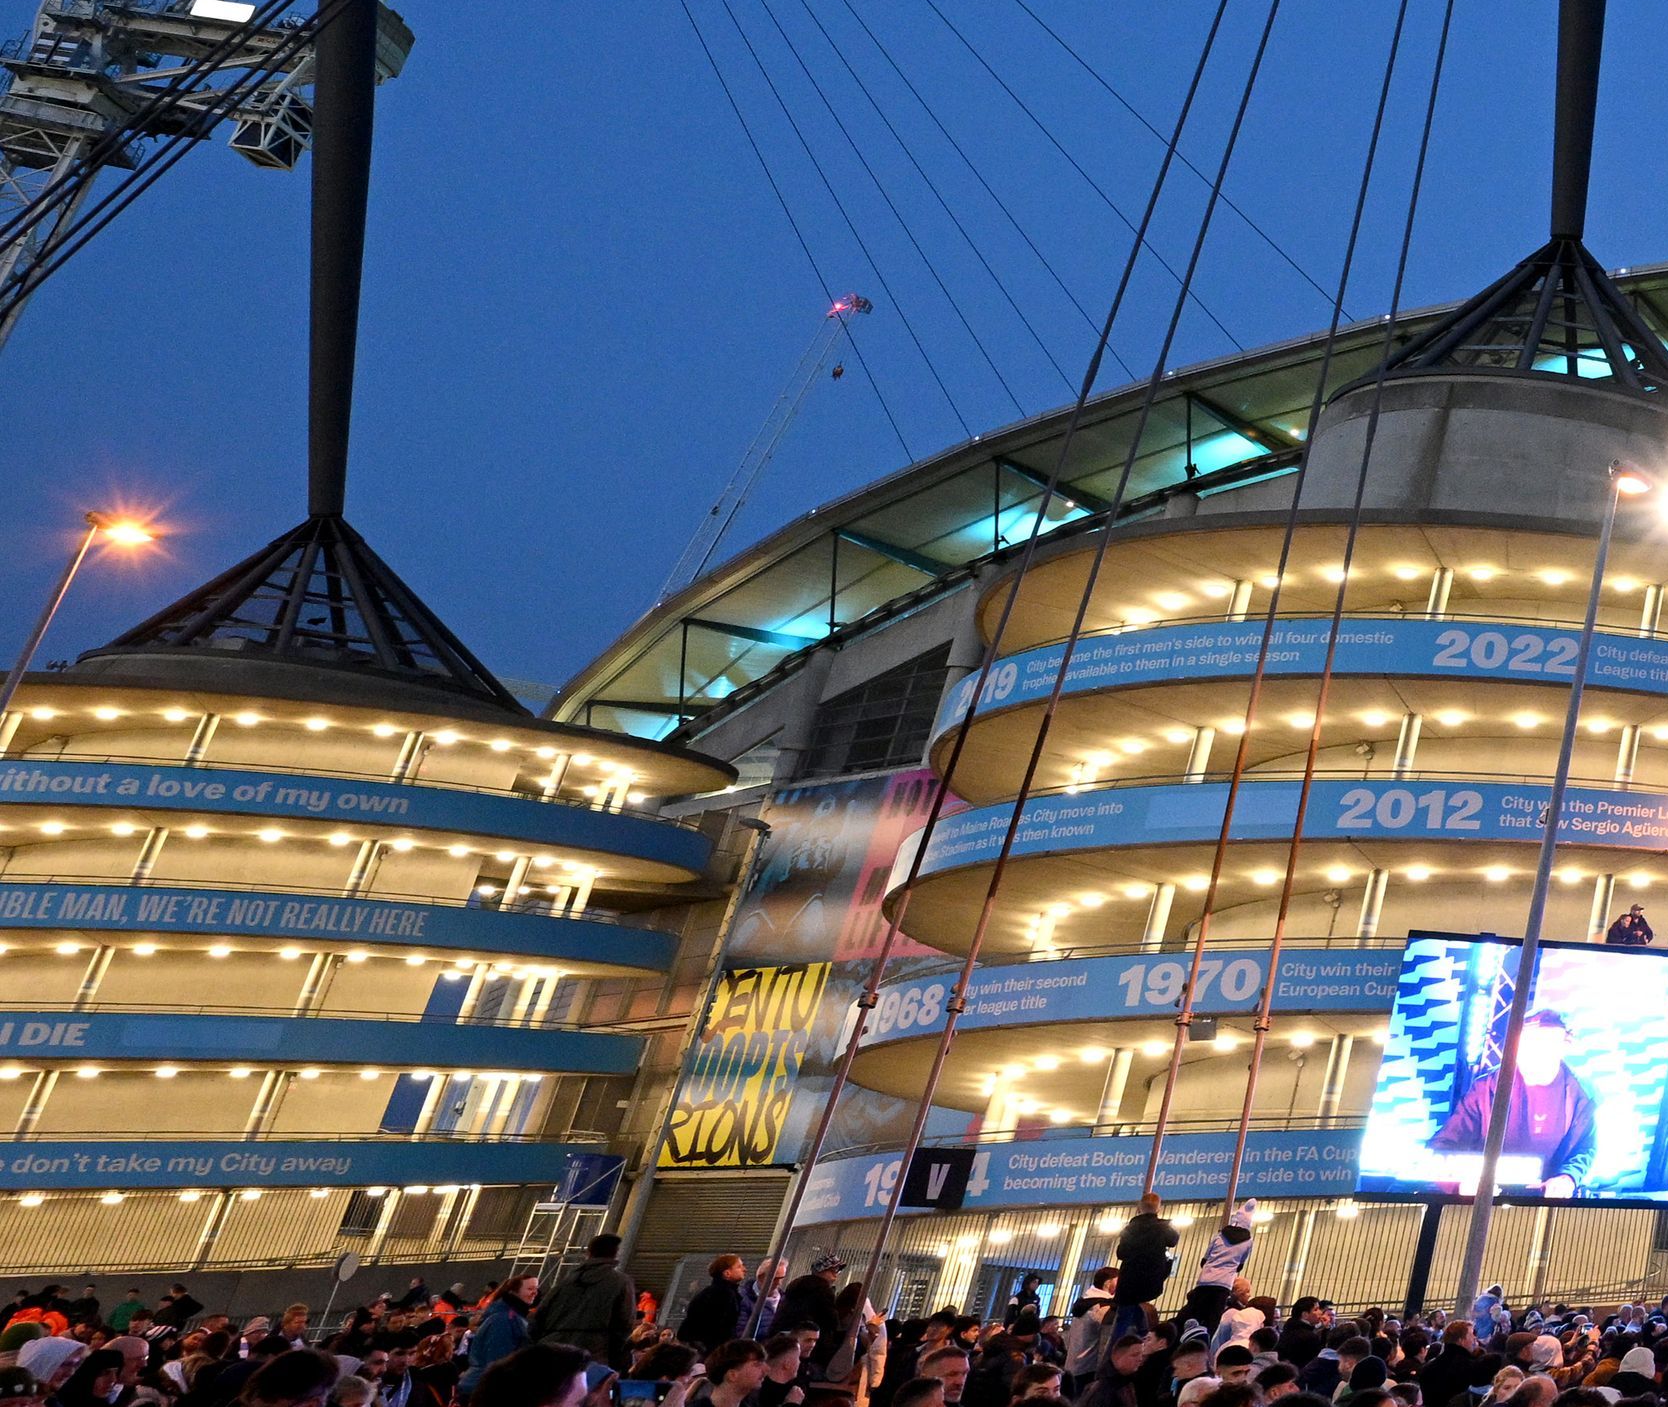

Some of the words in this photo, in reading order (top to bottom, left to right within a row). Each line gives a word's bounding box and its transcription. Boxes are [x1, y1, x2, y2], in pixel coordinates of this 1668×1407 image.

[1027, 659, 1046, 674] City
[1093, 648, 1112, 660] the
[1114, 643, 1141, 657] first
[1143, 638, 1182, 652] men's
[1185, 635, 1214, 648] side
[1217, 635, 1232, 646] to
[1235, 633, 1262, 645] win
[1285, 631, 1317, 644] four
[1432, 630, 1580, 674] 2022
[1596, 645, 1627, 662] City
[1063, 664, 1117, 682] available
[1119, 660, 1133, 673] to
[1135, 655, 1168, 670] them
[1171, 654, 1183, 666] in
[1198, 651, 1241, 666] single
[1595, 663, 1647, 681] League
[0, 770, 111, 794] ithout
[116, 778, 139, 796] a
[147, 775, 225, 800] love
[233, 781, 272, 803] of
[275, 788, 329, 812] my
[337, 793, 409, 814] own
[1033, 808, 1057, 823] City
[1059, 807, 1094, 820] move
[1097, 802, 1124, 816] into
[1336, 789, 1484, 830] 2012
[1501, 796, 1535, 812] City
[1569, 800, 1594, 814] the
[1597, 802, 1656, 818] Premier
[1499, 813, 1532, 829] that
[1571, 818, 1619, 836] Sergio
[58, 893, 128, 924] MAN,
[137, 895, 224, 926] WE'RE
[227, 899, 280, 929] NOT
[280, 903, 368, 933] REALLY
[369, 908, 428, 937] HERE
[1119, 959, 1261, 1007] 1970
[1282, 962, 1316, 979] City
[1320, 963, 1351, 977] win
[1354, 961, 1396, 977] their
[980, 981, 1003, 995] win
[1004, 976, 1033, 992] their
[1035, 972, 1088, 989] second
[1279, 982, 1361, 999] European
[1364, 981, 1398, 998] Cup
[868, 983, 945, 1036] 1968
[977, 998, 1018, 1015] league
[1020, 994, 1046, 1010] title
[18, 1023, 91, 1046] DIE
[12, 1153, 90, 1174] don't
[98, 1154, 161, 1173] take
[167, 1159, 212, 1175] my
[220, 1152, 273, 1175] City
[281, 1157, 351, 1176] away
[1008, 1155, 1038, 1172] City
[1040, 1152, 1090, 1168] defeat
[1092, 1149, 1145, 1167] Bolton
[1245, 1148, 1261, 1162] in
[1264, 1147, 1292, 1162] the
[1296, 1146, 1318, 1161] FA
[864, 1152, 990, 1207] 194
[925, 1163, 950, 1200] V
[1003, 1173, 1077, 1192] becoming
[1079, 1172, 1106, 1189] the
[1110, 1170, 1144, 1187] first
[1152, 1168, 1254, 1186] Mancheser
[1257, 1167, 1293, 1183] side
[1298, 1168, 1317, 1182] to
[1319, 1165, 1351, 1181] win
